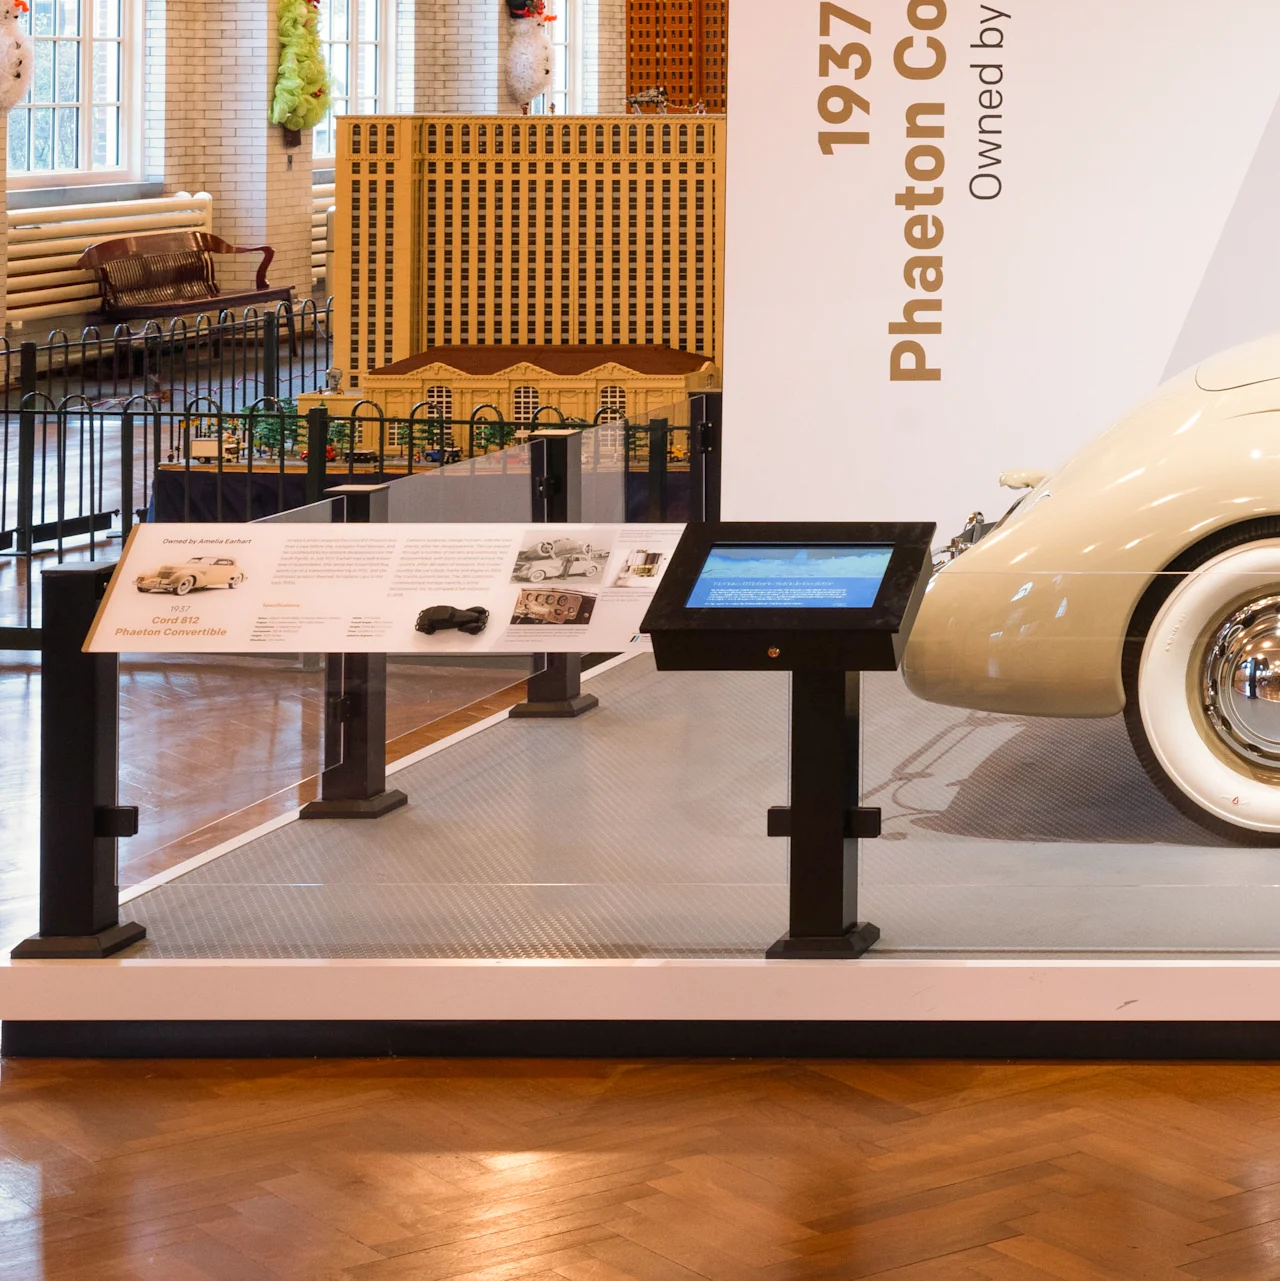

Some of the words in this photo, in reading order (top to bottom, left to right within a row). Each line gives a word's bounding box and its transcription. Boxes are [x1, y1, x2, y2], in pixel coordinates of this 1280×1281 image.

[969, 4, 1012, 49] by
[817, 1, 872, 156] 1937
[968, 64, 1004, 201] Owned
[888, 102, 945, 382] Phaeton
[188, 538, 198, 546] by
[151, 616, 179, 625] Cord
[180, 616, 200, 625] 812
[170, 605, 191, 613] 1937
[114, 628, 161, 636] Phaeton
[163, 628, 227, 636] Convertible
